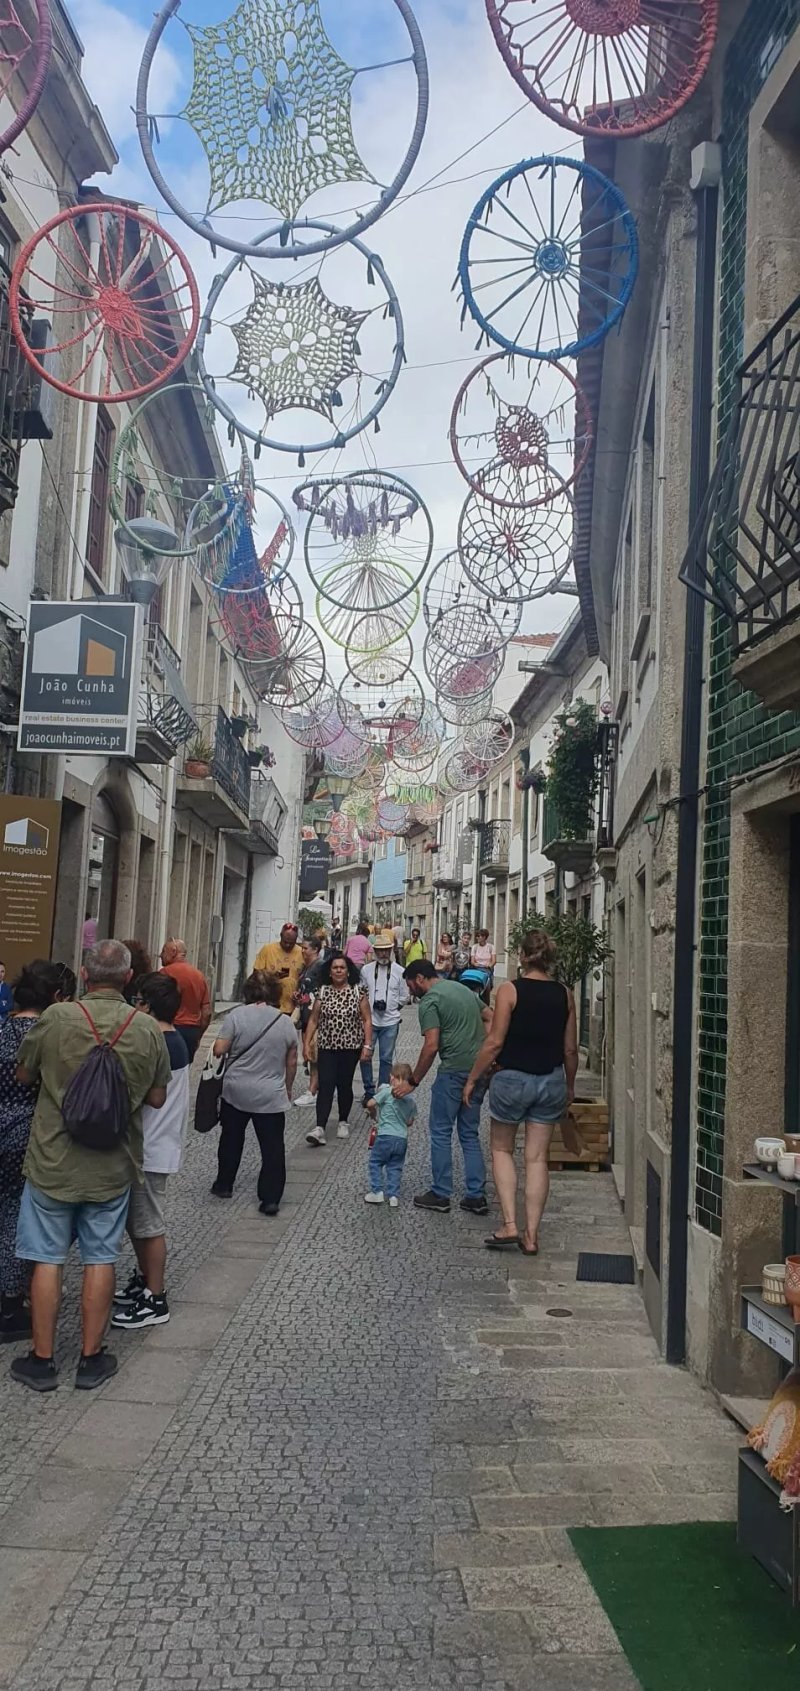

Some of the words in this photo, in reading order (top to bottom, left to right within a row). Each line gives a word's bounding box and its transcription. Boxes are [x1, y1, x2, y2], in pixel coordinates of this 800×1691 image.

[38, 677, 68, 694] João
[77, 679, 115, 693] Cunha
[62, 696, 91, 706] imóveis
[25, 714, 39, 722] real
[66, 716, 98, 724] business
[100, 717, 126, 725] center
[25, 730, 121, 749] joaocunhaimoveis.pt
[3, 843, 48, 857] Imogestão
